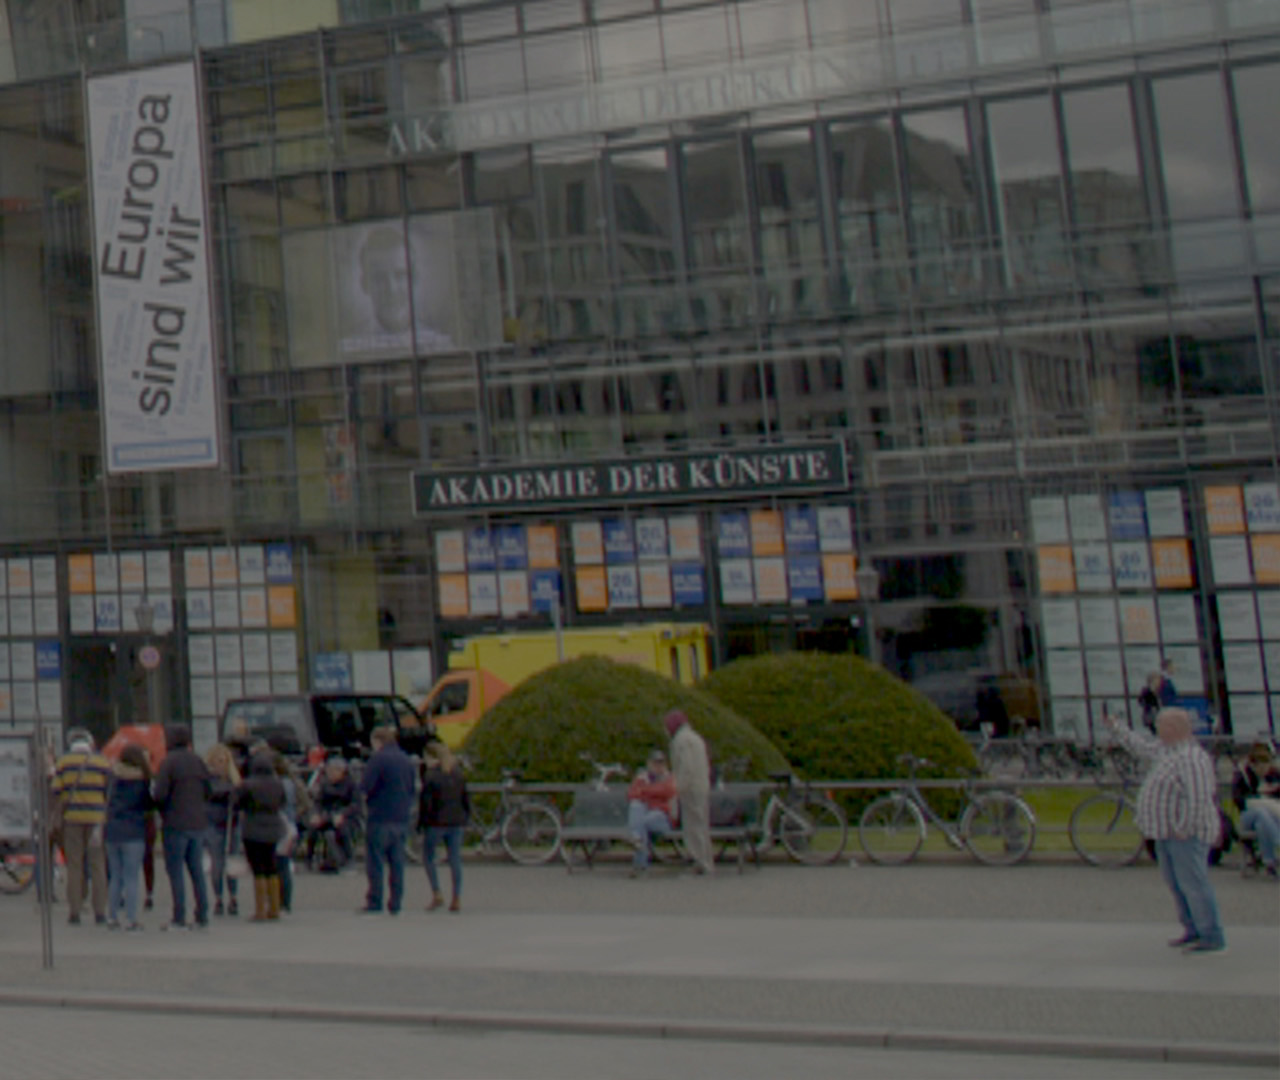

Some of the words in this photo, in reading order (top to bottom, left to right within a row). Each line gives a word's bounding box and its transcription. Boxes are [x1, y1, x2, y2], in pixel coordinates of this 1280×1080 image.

[101, 93, 174, 281] Europa
[156, 205, 202, 286] wir
[132, 302, 187, 417] sind
[428, 470, 600, 506] AKADEMIE
[610, 460, 680, 494] DER
[688, 449, 831, 488] KÜNSTE
